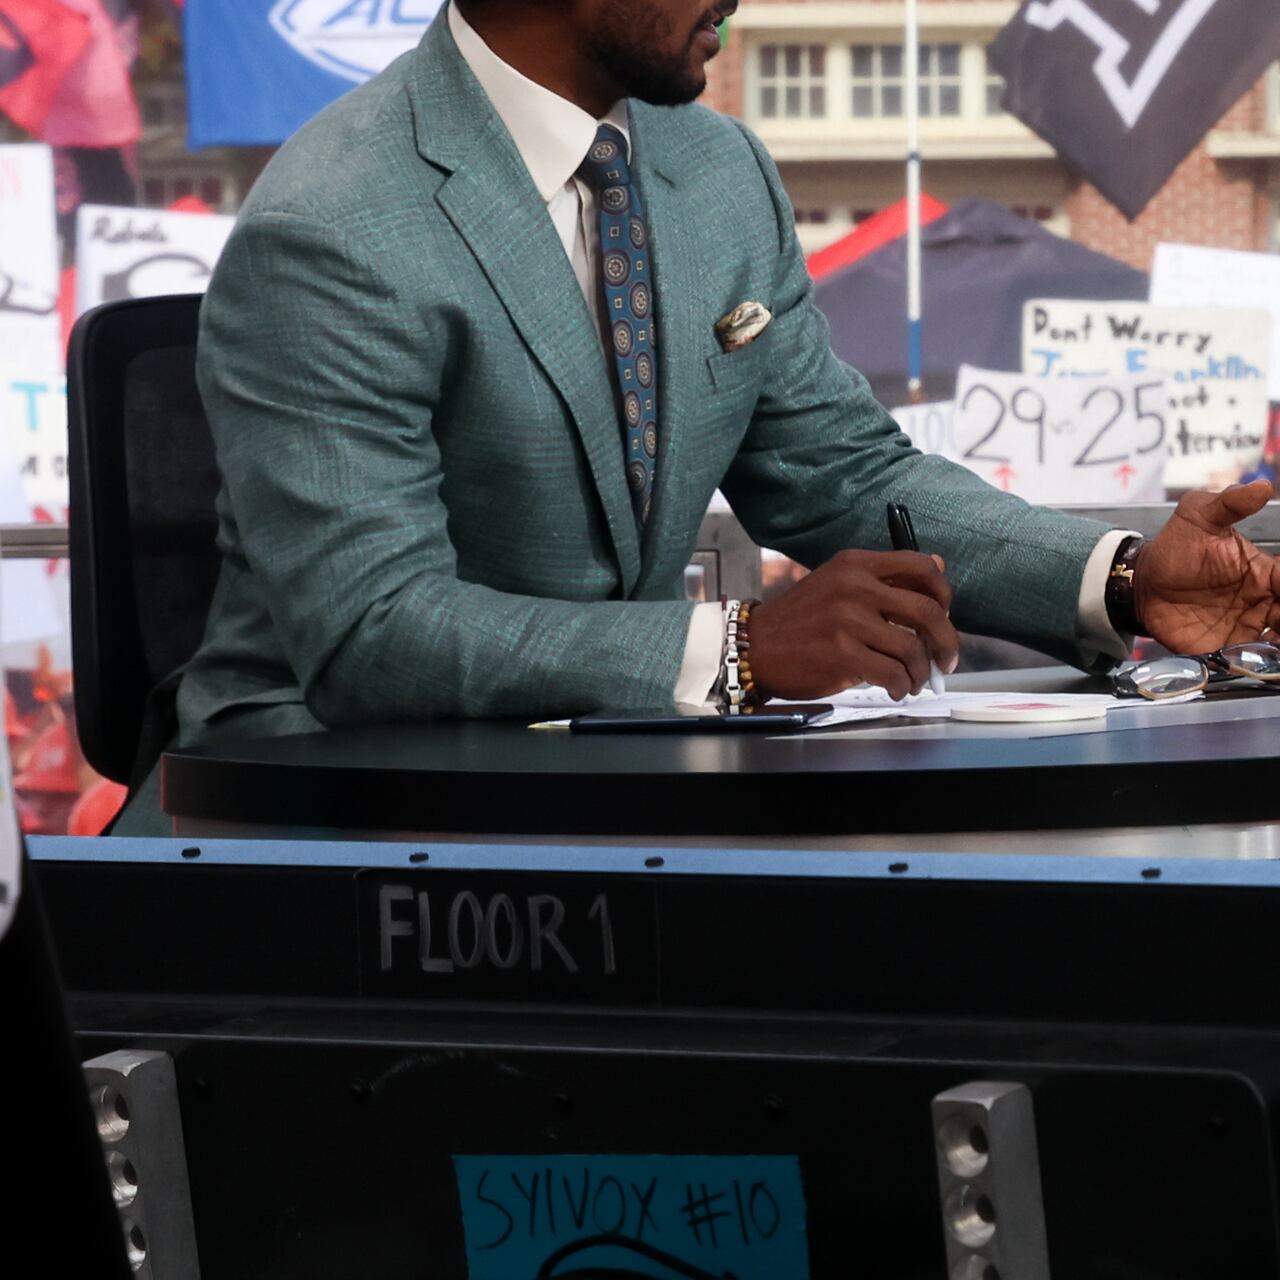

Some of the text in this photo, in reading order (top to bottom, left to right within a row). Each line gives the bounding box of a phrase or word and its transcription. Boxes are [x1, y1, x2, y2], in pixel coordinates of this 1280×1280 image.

[963, 384, 1046, 464] 29
[1073, 381, 1164, 467] 25
[378, 884, 579, 973] FLOOR
[680, 1179, 781, 1249] #10
